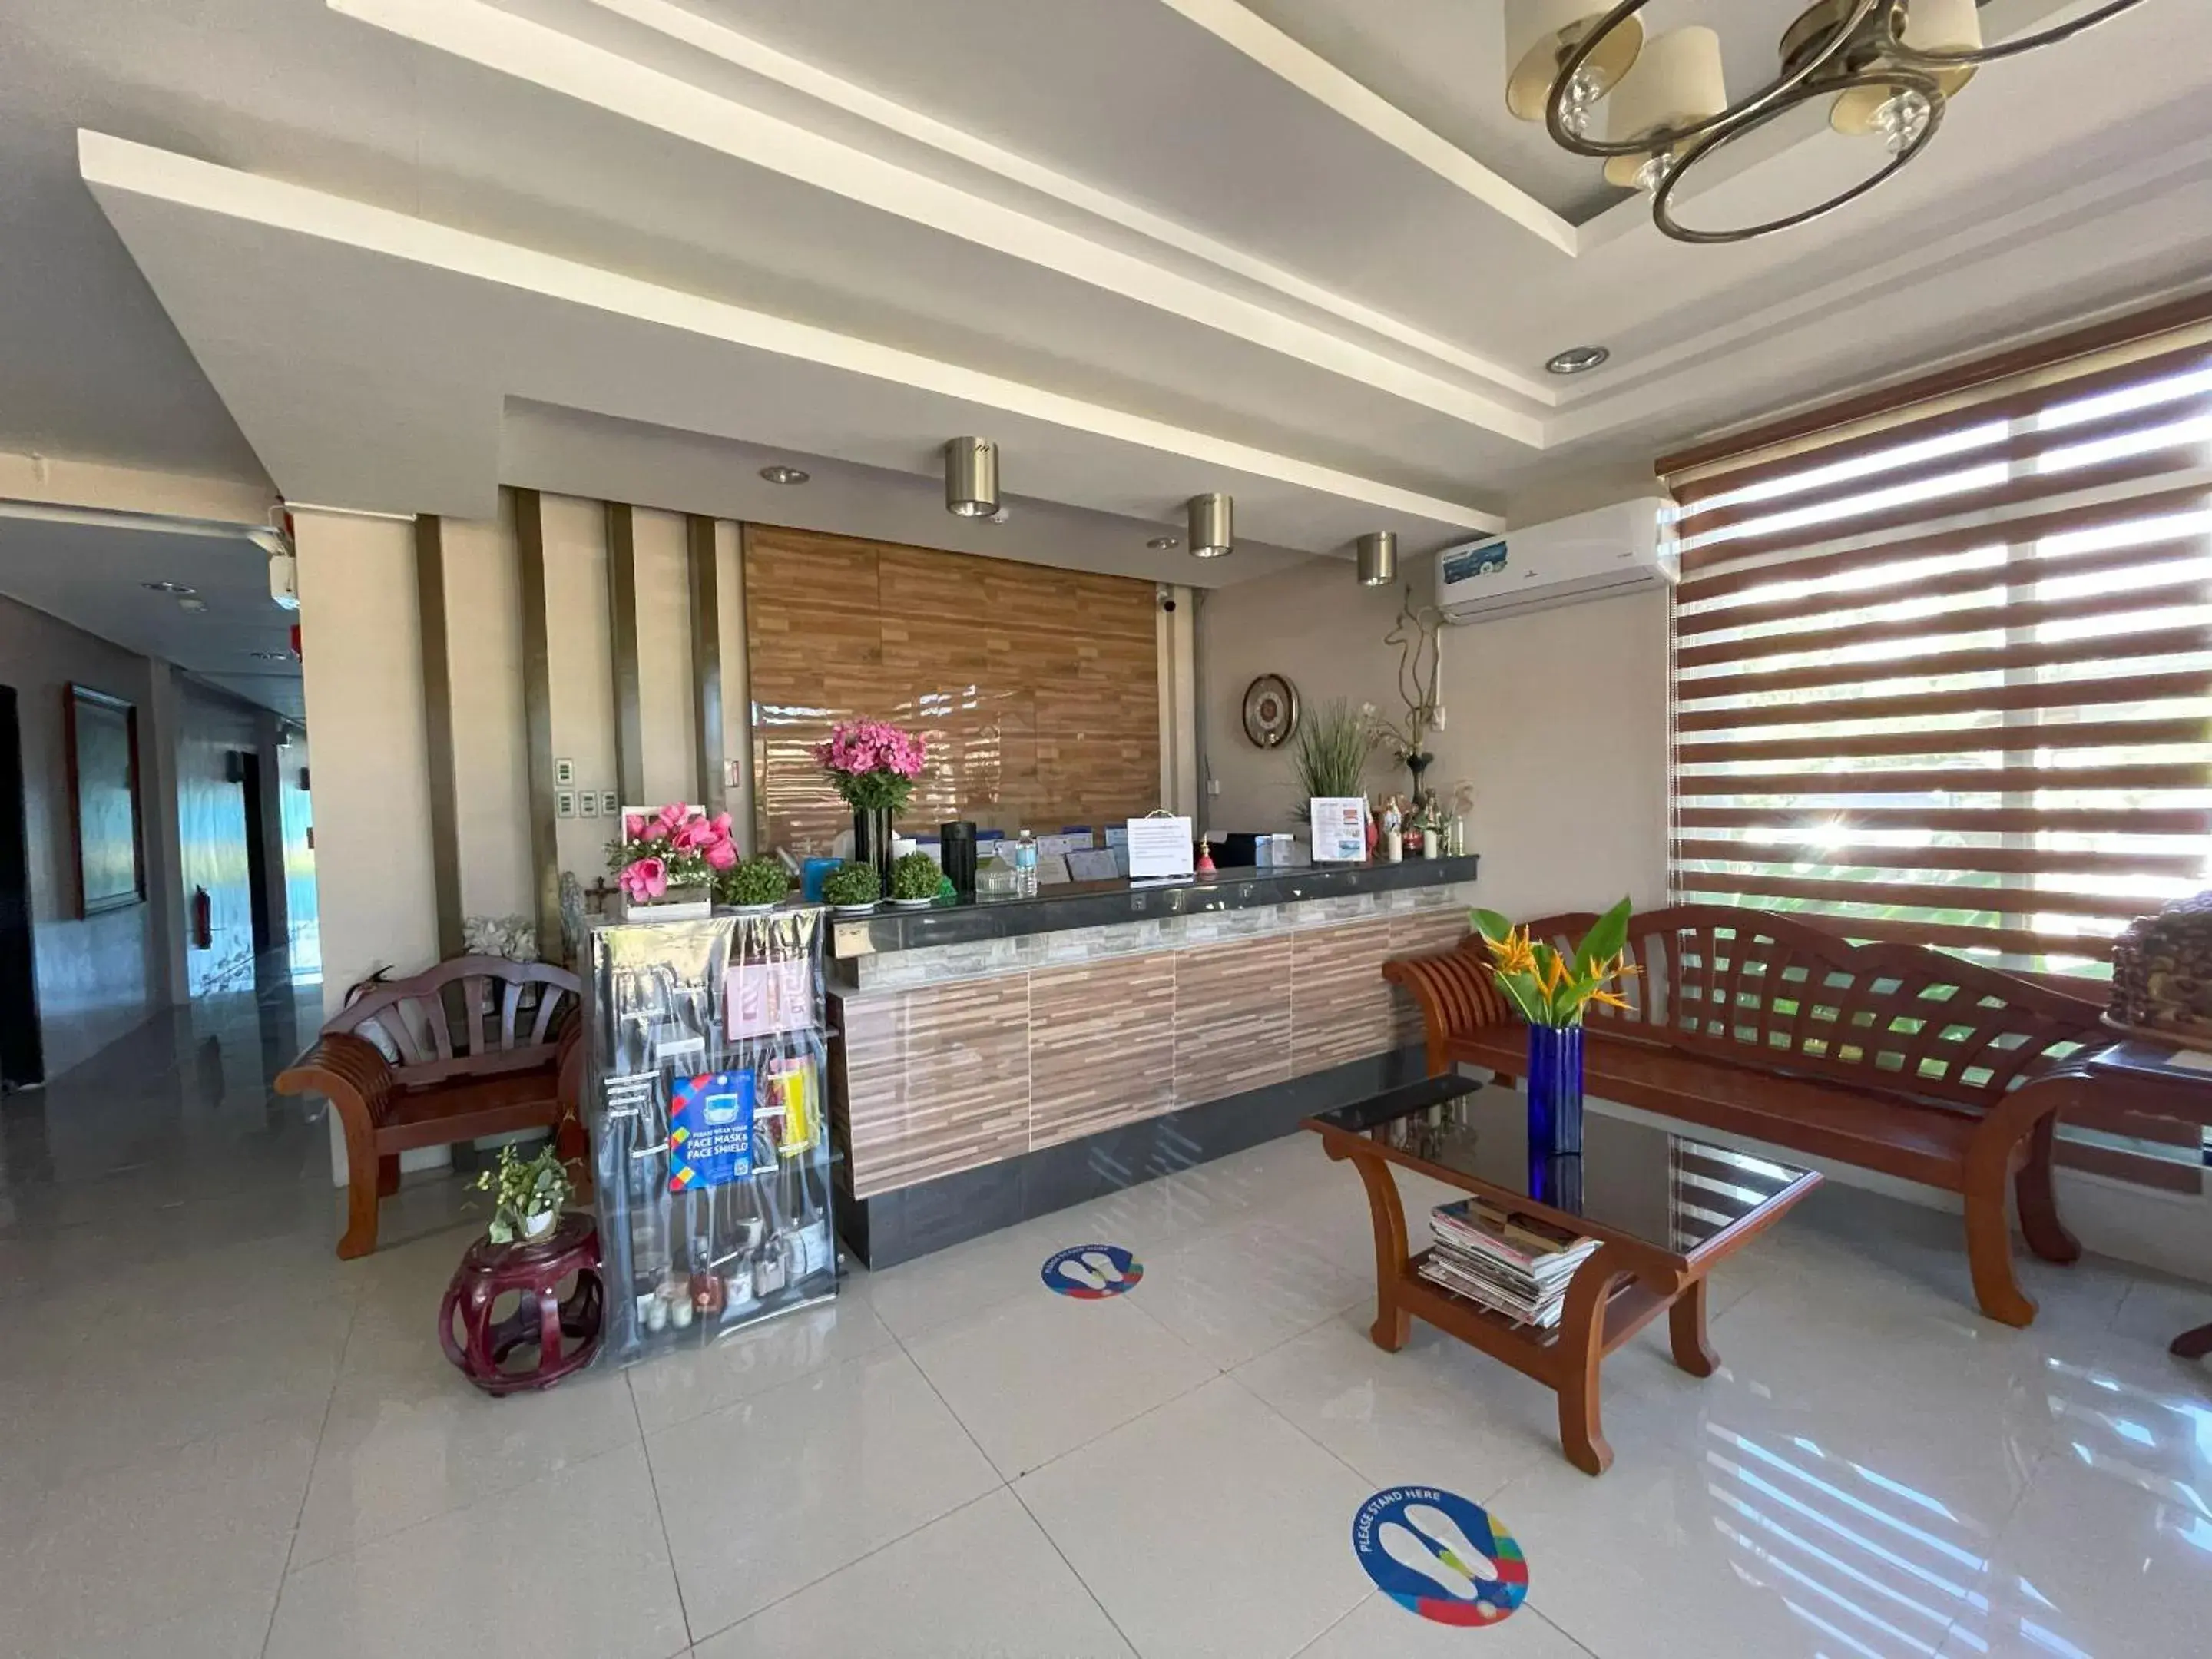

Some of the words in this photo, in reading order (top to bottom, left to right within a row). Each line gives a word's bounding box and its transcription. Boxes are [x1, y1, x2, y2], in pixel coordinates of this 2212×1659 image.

[687, 1137, 713, 1149] FACE
[714, 1134, 741, 1144] MASK
[687, 1147, 713, 1161] FACE
[714, 1142, 749, 1155] SHIELD
[1358, 1512, 1374, 1552] PLEASE
[1368, 1492, 1402, 1515] STAND
[1404, 1489, 1440, 1502] HERE
